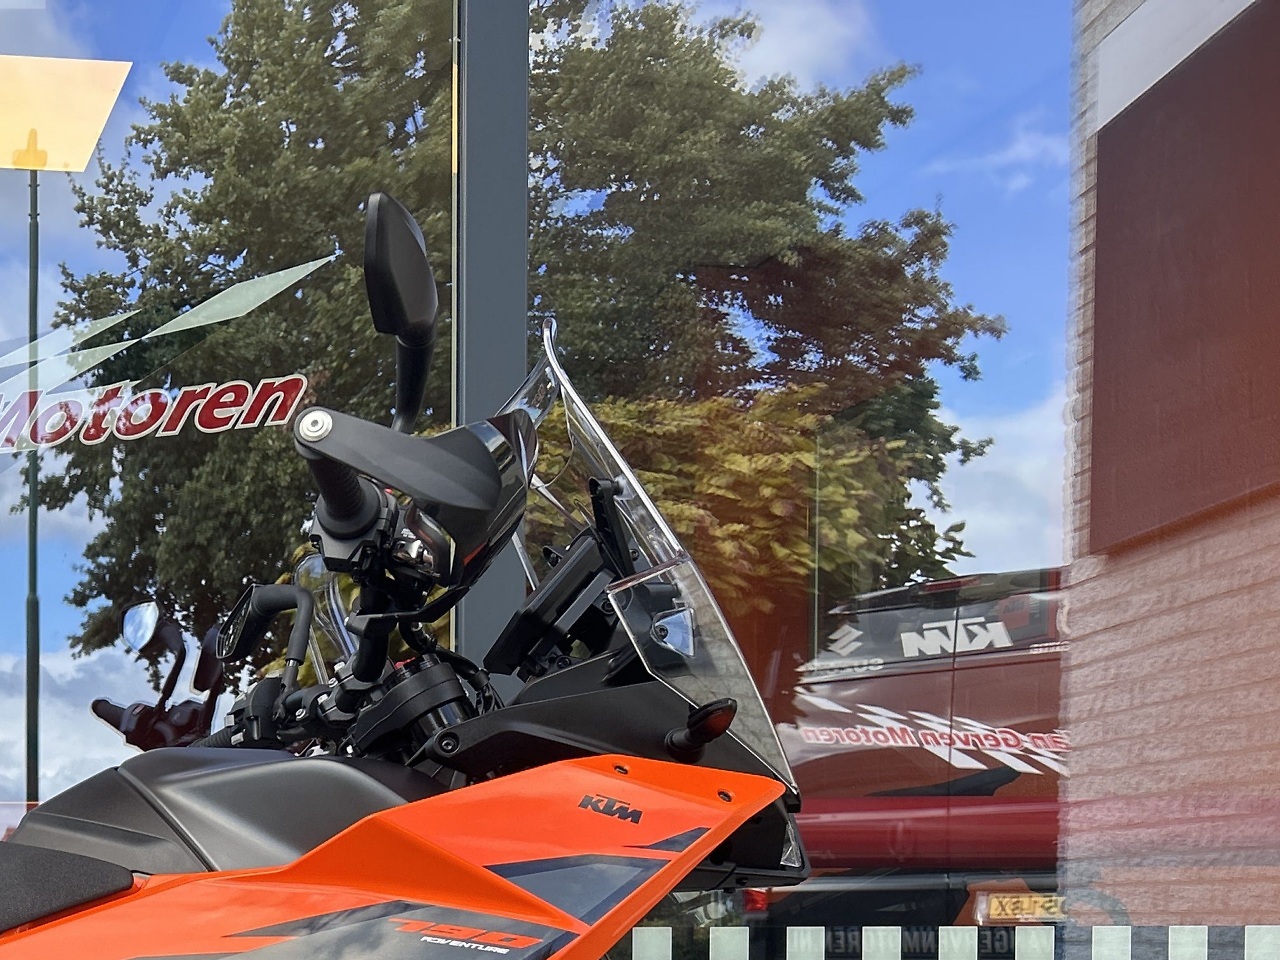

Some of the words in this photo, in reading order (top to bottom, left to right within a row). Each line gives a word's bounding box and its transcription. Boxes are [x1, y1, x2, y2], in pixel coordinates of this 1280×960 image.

[578, 793, 642, 825] KTM
[388, 918, 544, 950] 790
[419, 935, 510, 955] ADVENTURE
